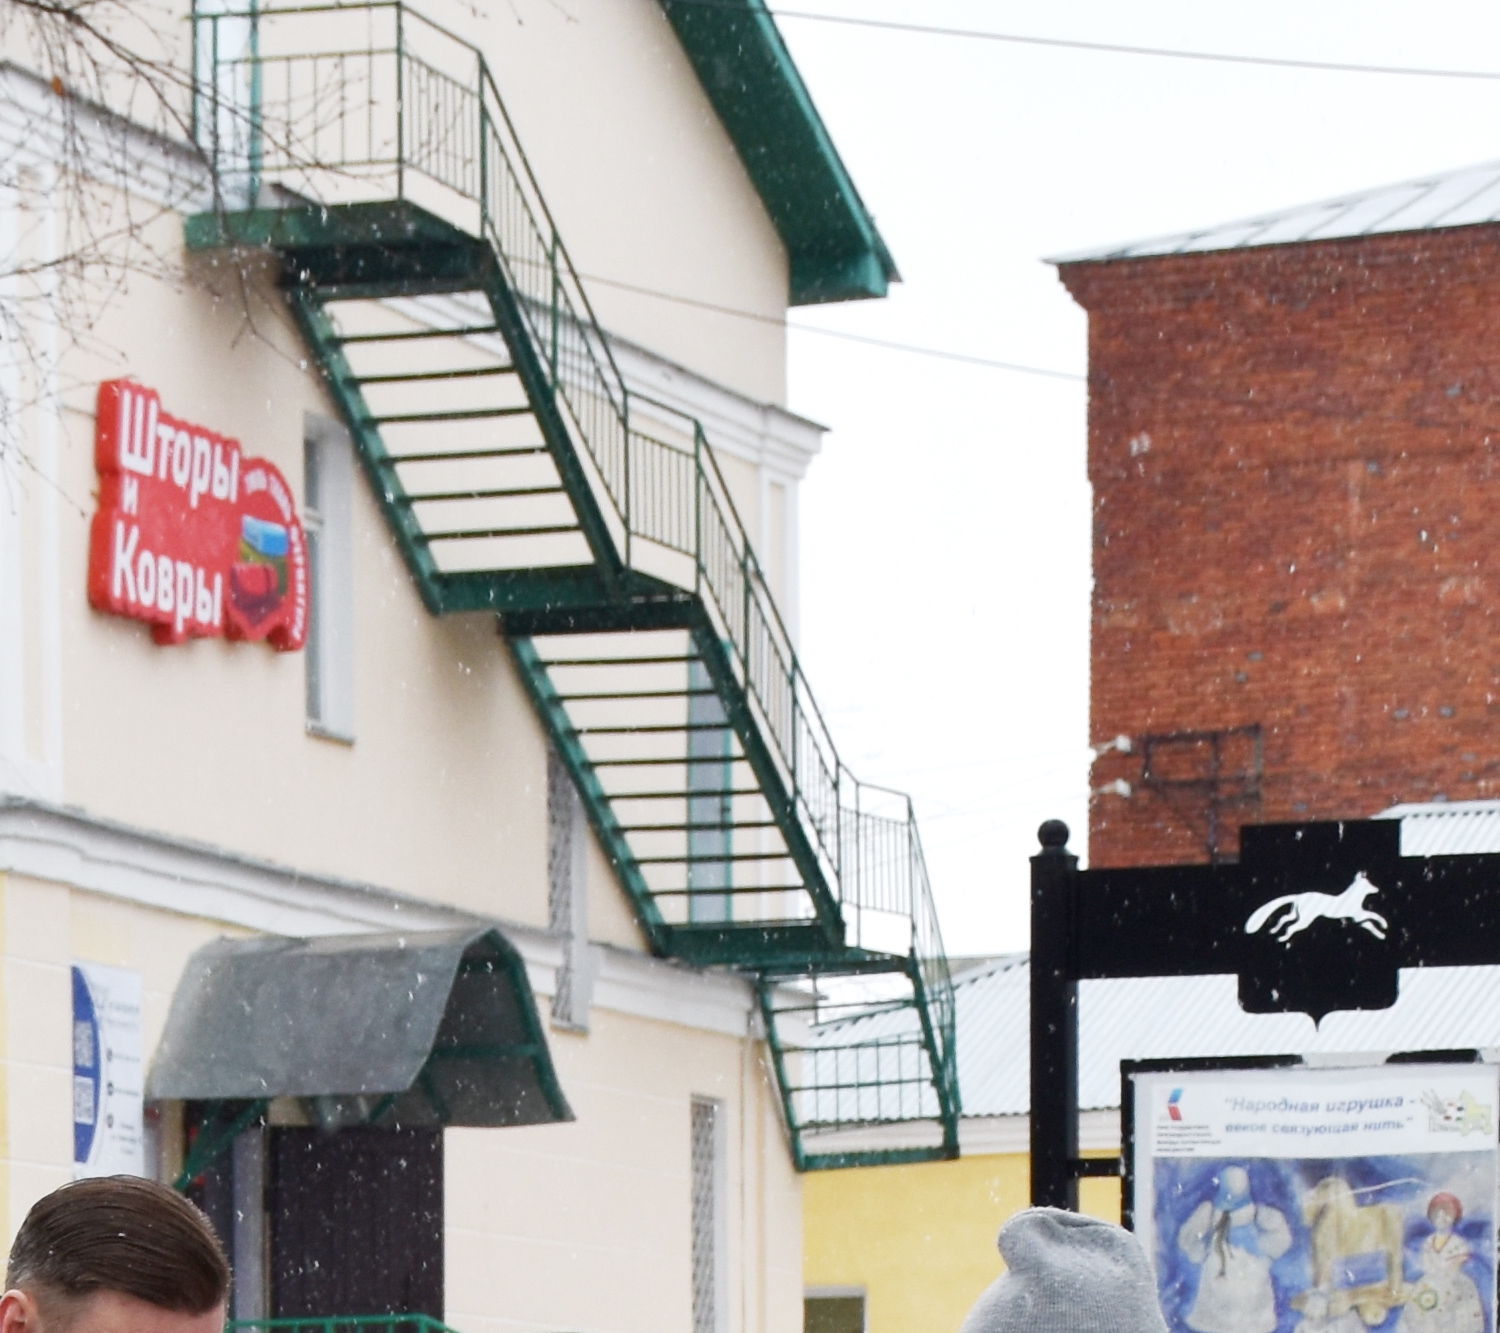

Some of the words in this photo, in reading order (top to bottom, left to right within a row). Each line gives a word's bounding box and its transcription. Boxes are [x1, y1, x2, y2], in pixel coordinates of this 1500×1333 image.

[119, 389, 241, 509] Шторы
[122, 474, 139, 516] и
[112, 520, 223, 634] Ковры
